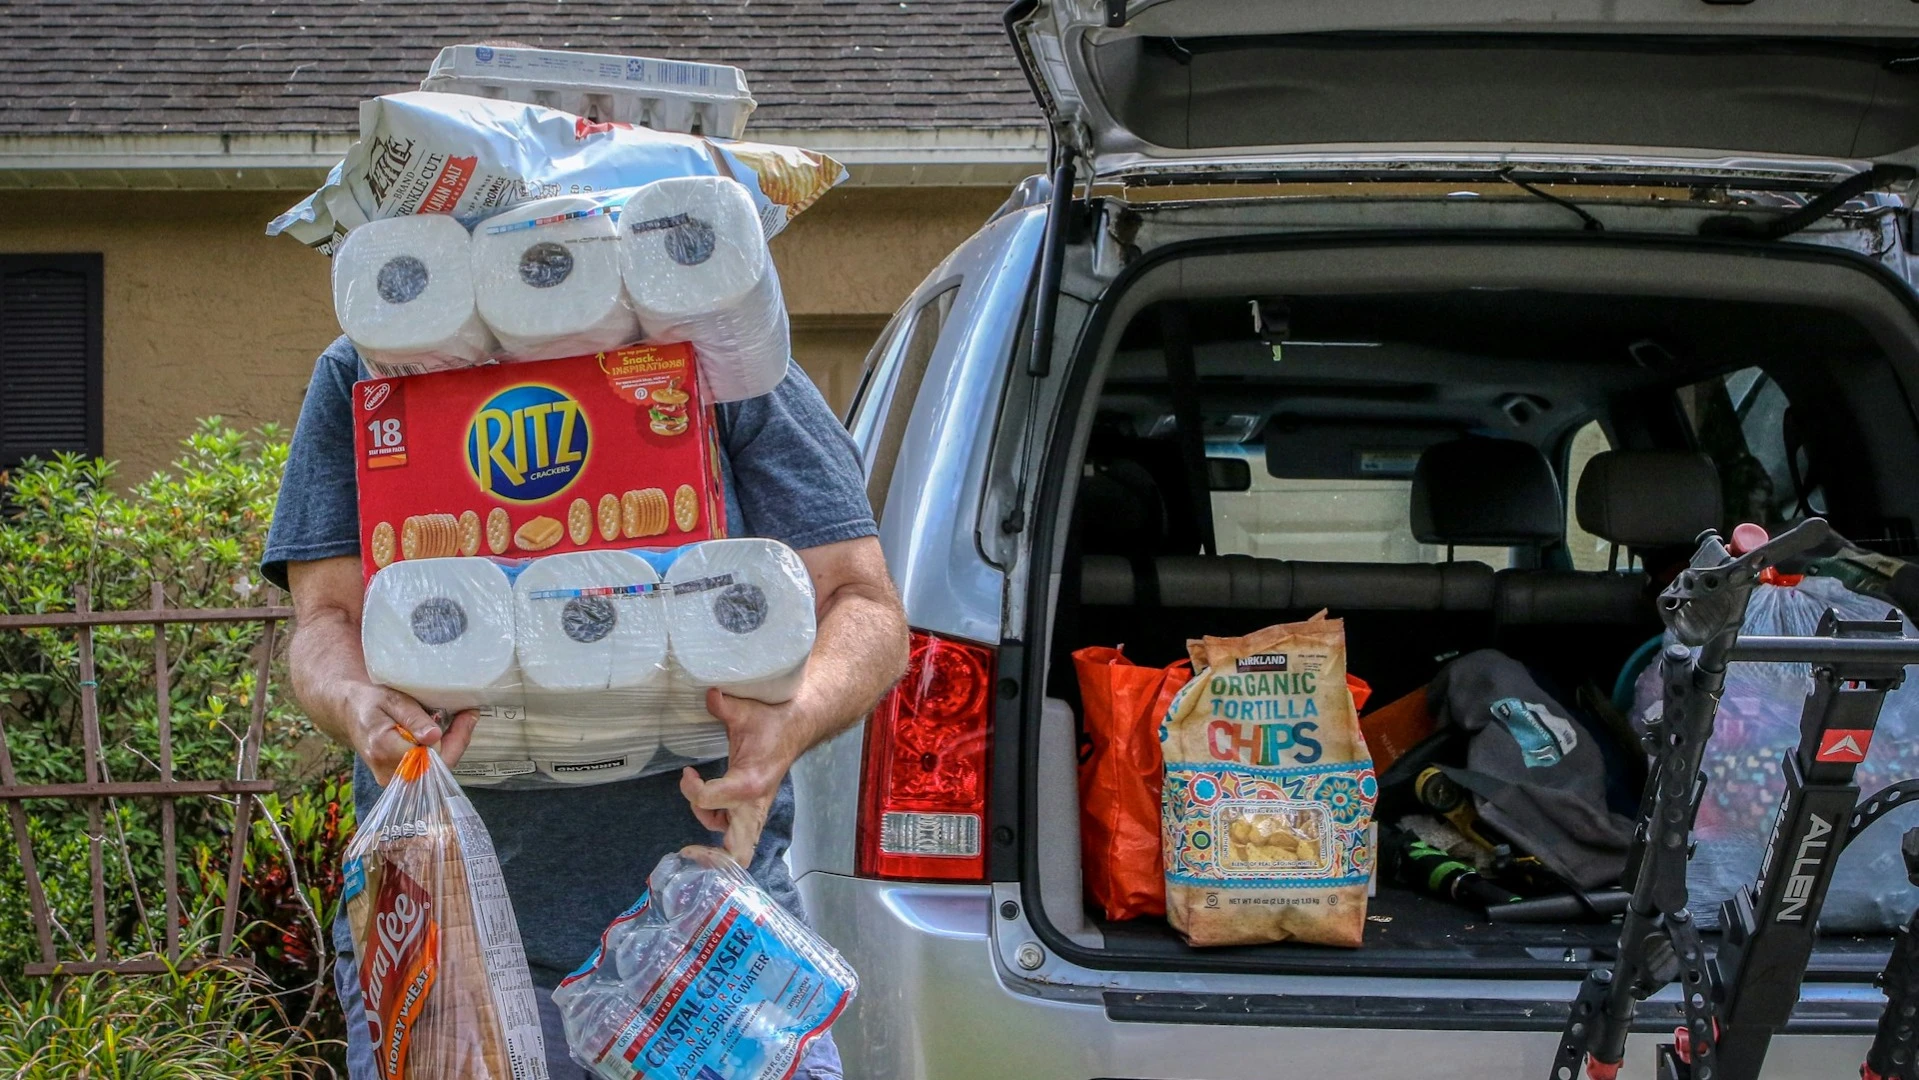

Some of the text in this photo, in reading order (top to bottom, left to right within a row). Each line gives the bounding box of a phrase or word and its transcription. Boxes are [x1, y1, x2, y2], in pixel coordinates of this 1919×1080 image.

[394, 171, 415, 199] BRAND
[394, 178, 429, 217] RINKLE
[424, 186, 449, 214] LAYAN
[442, 164, 462, 186] SALT
[623, 354, 655, 365] Snack
[368, 418, 402, 448] 18
[475, 400, 582, 492] RITZ
[530, 465, 571, 480] CRACKERS
[1238, 655, 1286, 667] KIRKLAND
[1210, 672, 1316, 696] ORGANIC
[1211, 698, 1319, 720] TORTILLA
[1207, 720, 1322, 766] CHIPS
[555, 761, 621, 772] KIRKLAND
[1776, 813, 1833, 922] ALLEN
[377, 893, 425, 971] Lee
[642, 931, 724, 1039] BOTTLED AT THE SOURCE
[644, 922, 757, 1070] CRYSTAL GEYSER
[387, 968, 428, 1076] HONEY WHEAT
[674, 953, 770, 1080] ALPINE SPRING WATER
[687, 973, 743, 1046] NATURAL
[508, 1038, 520, 1080] utrition
[720, 1036, 729, 1046] BY
